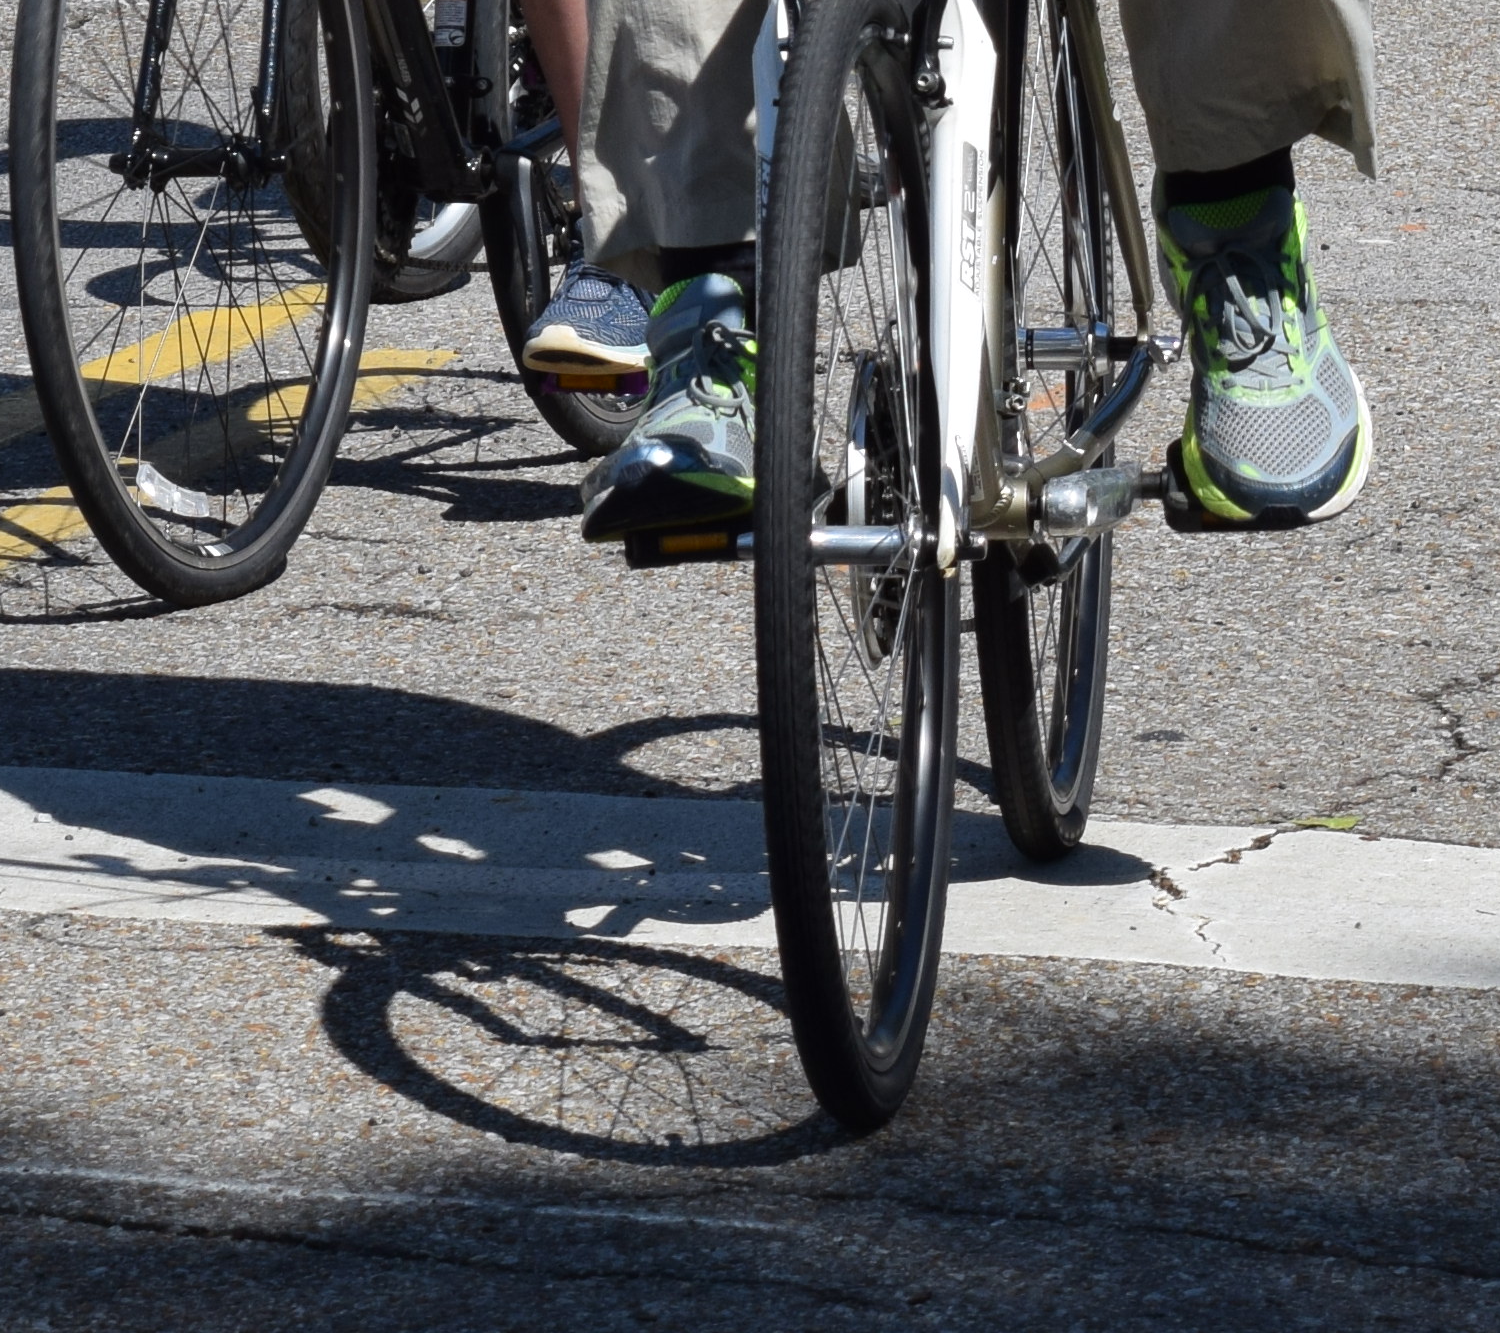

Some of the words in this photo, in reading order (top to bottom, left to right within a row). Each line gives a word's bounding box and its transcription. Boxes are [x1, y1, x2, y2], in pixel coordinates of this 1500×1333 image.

[977, 148, 985, 220] SUSPENSION
[960, 218, 976, 292] RST
[974, 225, 983, 297] ADJUSTABLE
